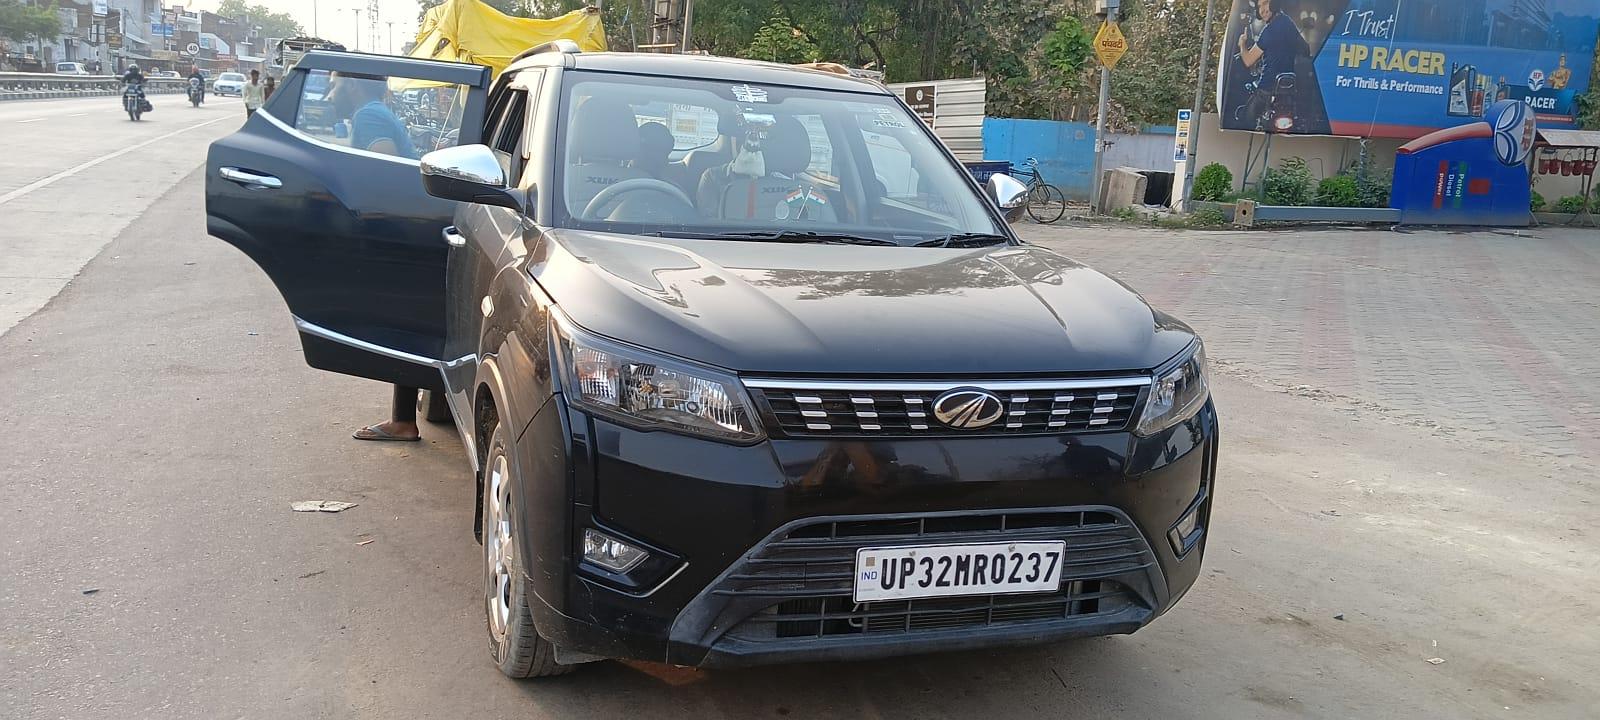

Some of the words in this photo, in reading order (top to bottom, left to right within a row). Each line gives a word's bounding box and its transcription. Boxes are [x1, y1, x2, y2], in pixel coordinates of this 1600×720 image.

[1341, 9, 1359, 36] I
[1359, 10, 1395, 39] Trust
[1338, 43, 1368, 69] HP
[1370, 47, 1446, 77] RACER
[1335, 75, 1352, 88] For
[1353, 76, 1380, 91] Thrills
[1381, 78, 1389, 91] &
[1390, 79, 1444, 95] Performance
[1525, 96, 1555, 110] RACER
[872, 120, 905, 129] PETROL
[1446, 174, 1455, 197] Diesel
[1455, 173, 1465, 198] Petrol
[861, 570, 878, 581] IND
[879, 551, 1060, 590] UP32MR0237
